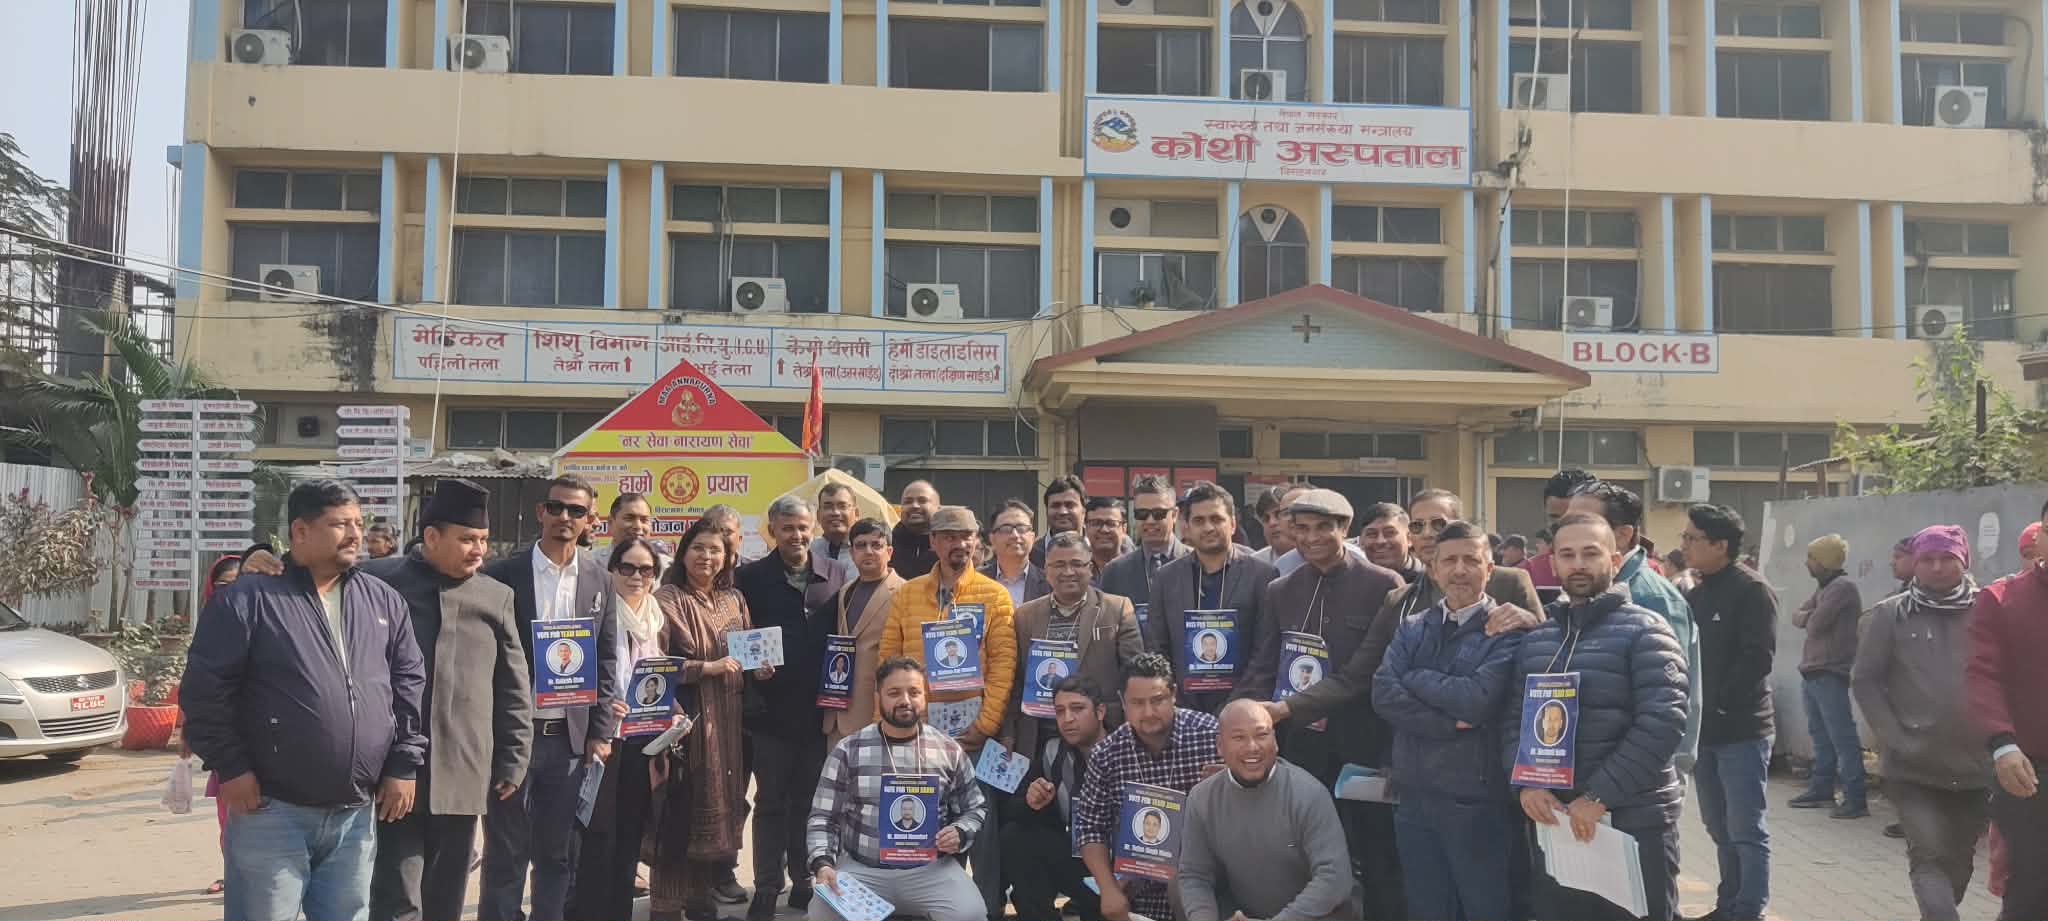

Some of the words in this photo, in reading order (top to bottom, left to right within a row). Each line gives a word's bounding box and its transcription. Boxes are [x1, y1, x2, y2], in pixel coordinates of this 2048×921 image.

[1263, 122, 1290, 135] तथा
[1150, 132, 1262, 163] कोशी
[1276, 140, 1468, 169] अस्पताल
[1572, 341, 1711, 364] BLOCK-B
[468, 357, 500, 371] तला
[588, 361, 620, 373] तला
[721, 363, 753, 377] तला
[646, 432, 669, 448] सेवा
[673, 435, 723, 448] नारायण
[705, 474, 750, 495] प्रयास
